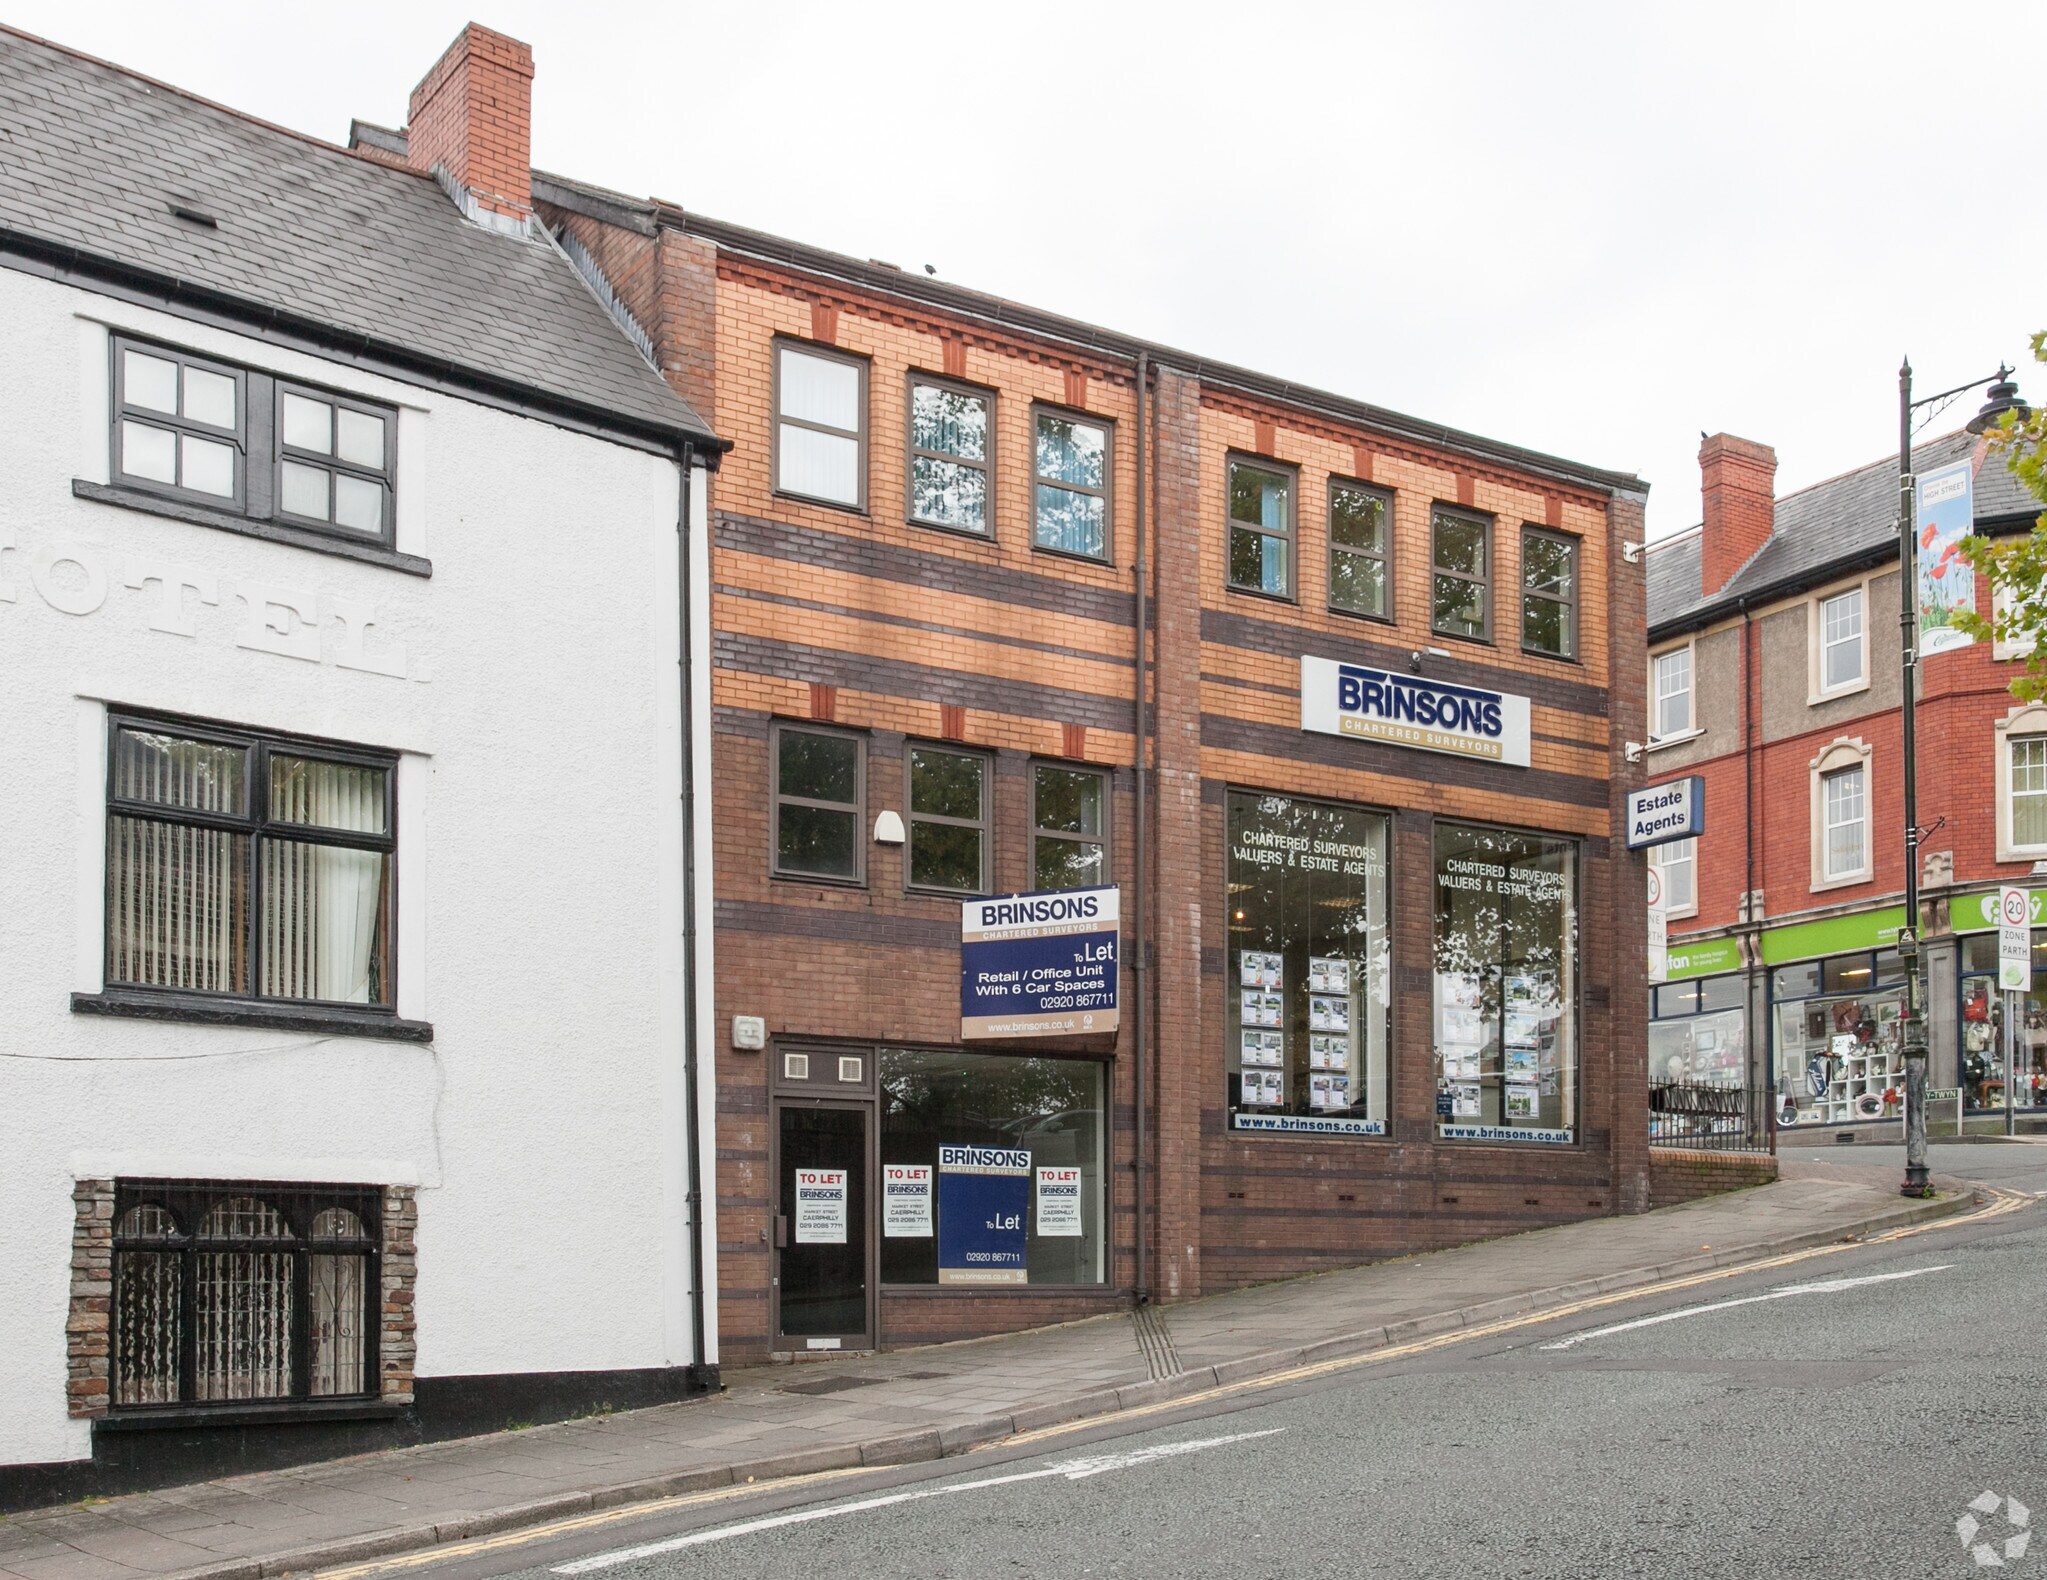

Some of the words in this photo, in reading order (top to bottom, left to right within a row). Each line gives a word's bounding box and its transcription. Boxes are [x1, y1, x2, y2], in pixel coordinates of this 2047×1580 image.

[1940, 481, 1965, 495] STREET
[1339, 676, 1503, 737] BRINSONS
[1345, 719, 1421, 742] CHARTERED
[1426, 732, 1499, 755] SURVEYORS
[1636, 791, 1683, 814] Estate
[1634, 812, 1685, 836] Agents
[1242, 830, 1309, 851] CHARTERED
[1313, 840, 1377, 860] SURVEYORS
[1233, 846, 1283, 865] VALUERS
[1287, 853, 1296, 867] &
[1300, 854, 1339, 872] ESTATE
[1343, 860, 1385, 878] AGENTS
[1446, 859, 1506, 878] CHARTERED
[1509, 866, 1566, 886] SURVEYORS
[1438, 873, 1482, 891] VALUERS
[1485, 880, 1493, 892] &
[1497, 881, 1531, 897] ESTATE
[1535, 886, 1573, 902] AGENTS
[1649, 880, 1658, 895] 0
[981, 896, 1099, 926] BRINSONS
[2007, 900, 2023, 915] 20
[1648, 914, 1660, 924] NE
[982, 928, 1039, 940] CHARTERED
[1042, 922, 1098, 936] SURVEYORS
[2004, 930, 2025, 941] ZONE
[1074, 953, 1084, 963] To
[1085, 941, 1114, 962] Let
[2002, 945, 2028, 956] PARTH
[978, 970, 1019, 983] Retail
[1031, 968, 1072, 980] Office
[1075, 965, 1104, 977] Unit
[975, 985, 1008, 996] With
[1012, 983, 1022, 994] 6
[1025, 982, 1051, 993] Car
[1054, 979, 1105, 993] Spaces
[1040, 996, 1074, 1009] 02920
[1076, 993, 1113, 1006] 867711
[987, 1018, 1075, 1032] www.brinsons.co.uk
[1239, 1117, 1382, 1134] www.brinsons.co.uk
[1443, 1127, 1570, 1142] www.brinsons.co.uk
[942, 1149, 1029, 1168] BRINSONS
[800, 1173, 816, 1184] TO
[820, 1174, 843, 1184] LET
[888, 1169, 903, 1179] TO
[907, 1169, 928, 1179] LET
[942, 1166, 984, 1174] CHARTERED
[986, 1167, 1028, 1176] SURVEYORS
[1040, 1171, 1055, 1181] TO
[1058, 1171, 1078, 1181] LET
[800, 1190, 843, 1198] BRINSONS
[985, 1220, 994, 1229] To
[995, 1212, 1020, 1229] Let
[966, 1252, 991, 1262] 02920
[991, 1252, 1020, 1262] 867711
[949, 1272, 1010, 1281] www.brinsons.co.uk
